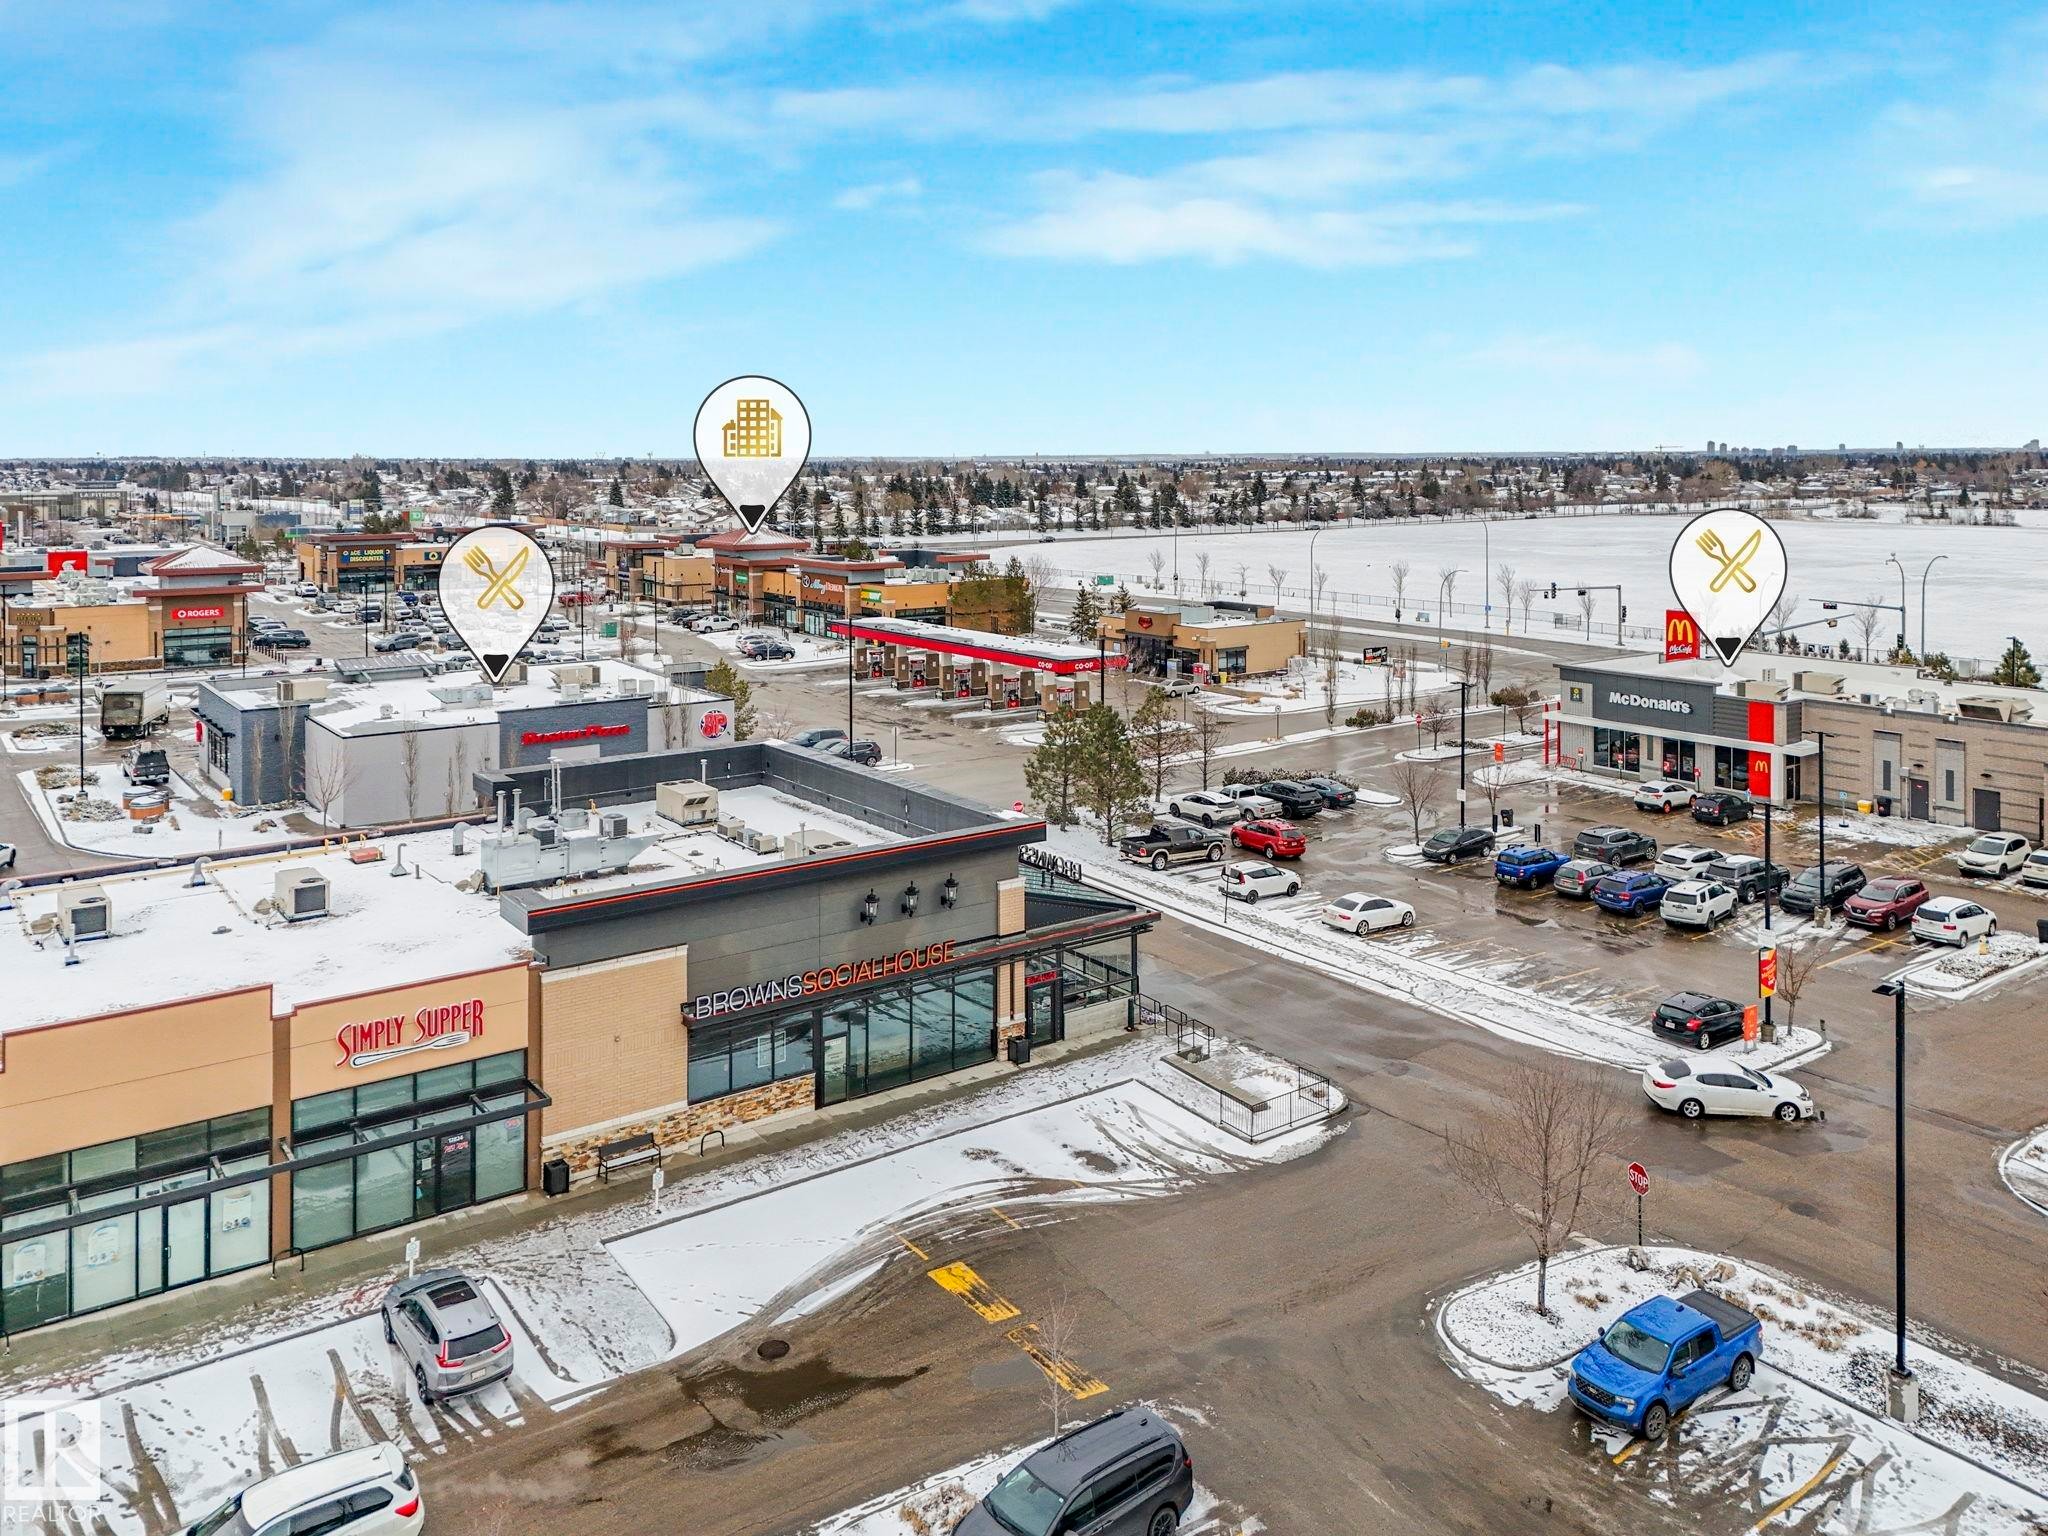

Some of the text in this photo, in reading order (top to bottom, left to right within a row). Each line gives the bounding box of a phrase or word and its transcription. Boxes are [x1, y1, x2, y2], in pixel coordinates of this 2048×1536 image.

[187, 608, 220, 618] ROGERS
[1074, 661, 1094, 670] CO-OP
[1608, 691, 1692, 714] McDonald's
[336, 997, 484, 1067] SIMPLY SUPPER
[1629, 1168, 1648, 1188] STOP
